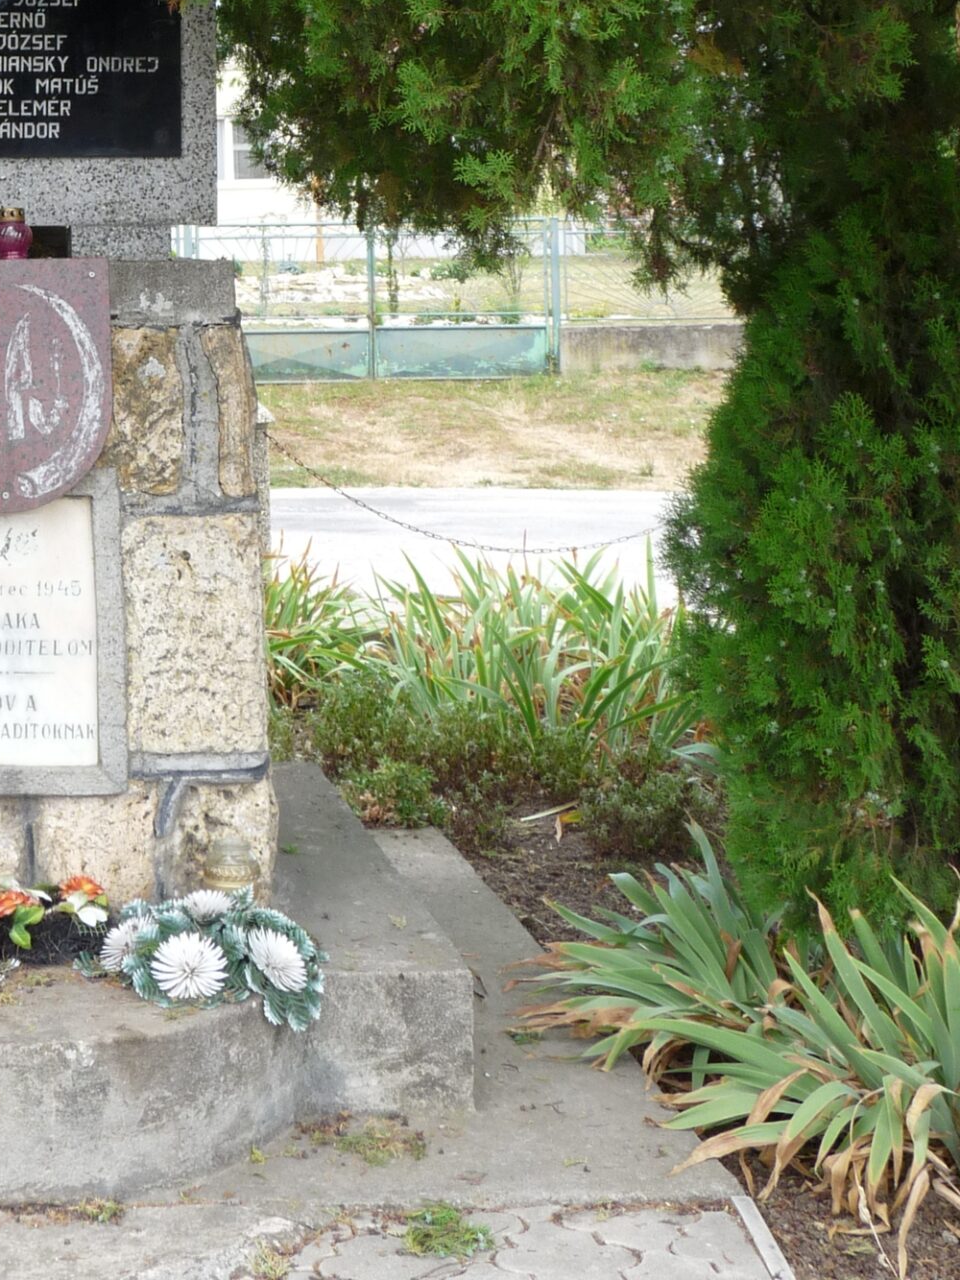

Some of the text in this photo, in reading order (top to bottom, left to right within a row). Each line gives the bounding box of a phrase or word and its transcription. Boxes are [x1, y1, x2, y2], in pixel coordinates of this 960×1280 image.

[86, 56, 160, 73] ONDREJ
[35, 74, 100, 95] MATÚŠ
[36, 579, 82, 597] 1945
[25, 693, 38, 712] A
